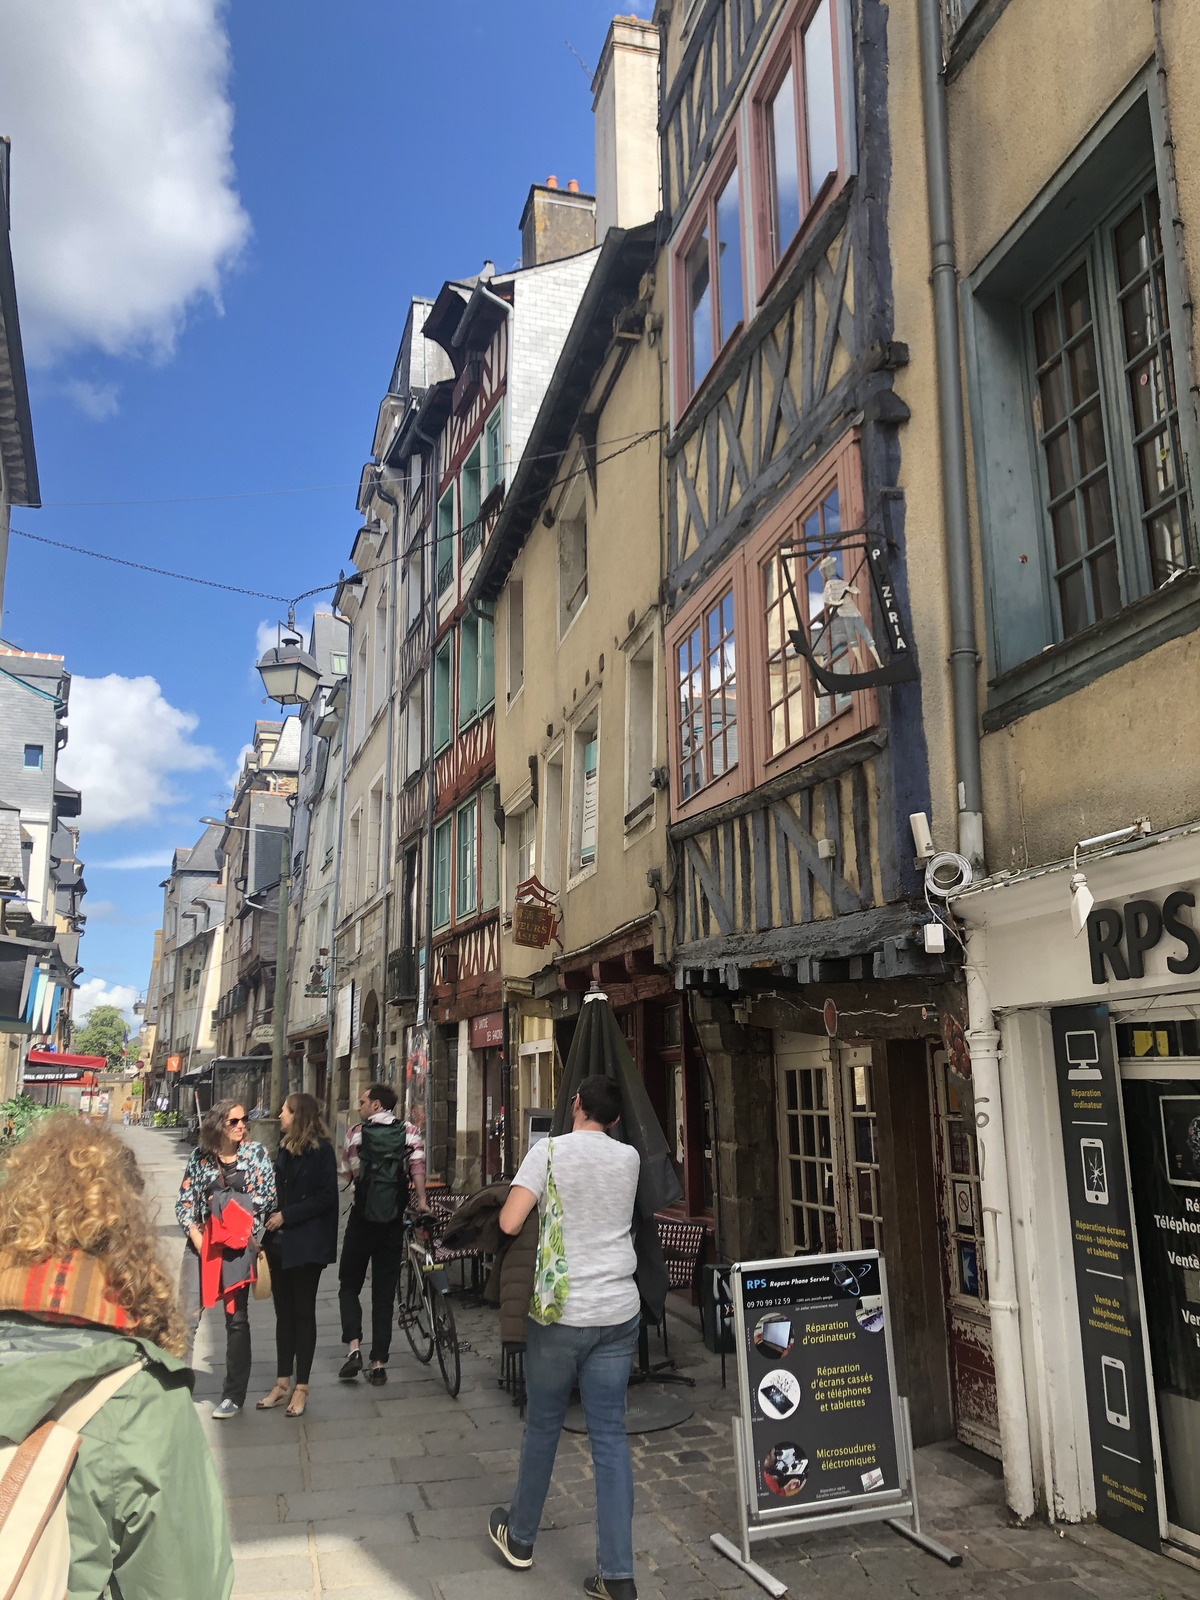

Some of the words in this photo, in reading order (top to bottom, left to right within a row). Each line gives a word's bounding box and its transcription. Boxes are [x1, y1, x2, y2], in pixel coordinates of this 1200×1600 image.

[1087, 891, 1200, 985] RPS
[1071, 1088, 1102, 1098] Réparation
[1074, 1100, 1102, 1109] ordinateur
[1076, 1220, 1106, 1232] Réparation
[1106, 1225, 1126, 1237] écrans
[1075, 1234, 1092, 1242] cassés
[1096, 1236, 1129, 1250] téléphones
[1093, 1248, 1119, 1260] tablettes
[746, 1278, 766, 1290] RPS
[1094, 1294, 1111, 1306] Vente
[1112, 1298, 1120, 1308] de
[1092, 1306, 1125, 1322] téléphones
[806, 1321, 849, 1334] Réparation
[1089, 1319, 1132, 1337] reconditionnés
[802, 1331, 856, 1345] d'ordinateurs
[817, 1364, 860, 1376] Réparation
[811, 1377, 845, 1389] d'écrans
[847, 1372, 874, 1384] cassés
[815, 1391, 825, 1401] de
[827, 1386, 872, 1399] téléphones
[820, 1403, 828, 1412] et
[831, 1398, 866, 1411] tablettes
[816, 1443, 876, 1458] Microsoudures
[821, 1455, 876, 1470] éléctroniques
[1102, 1474, 1119, 1488] Micro
[1123, 1484, 1148, 1501] soudure
